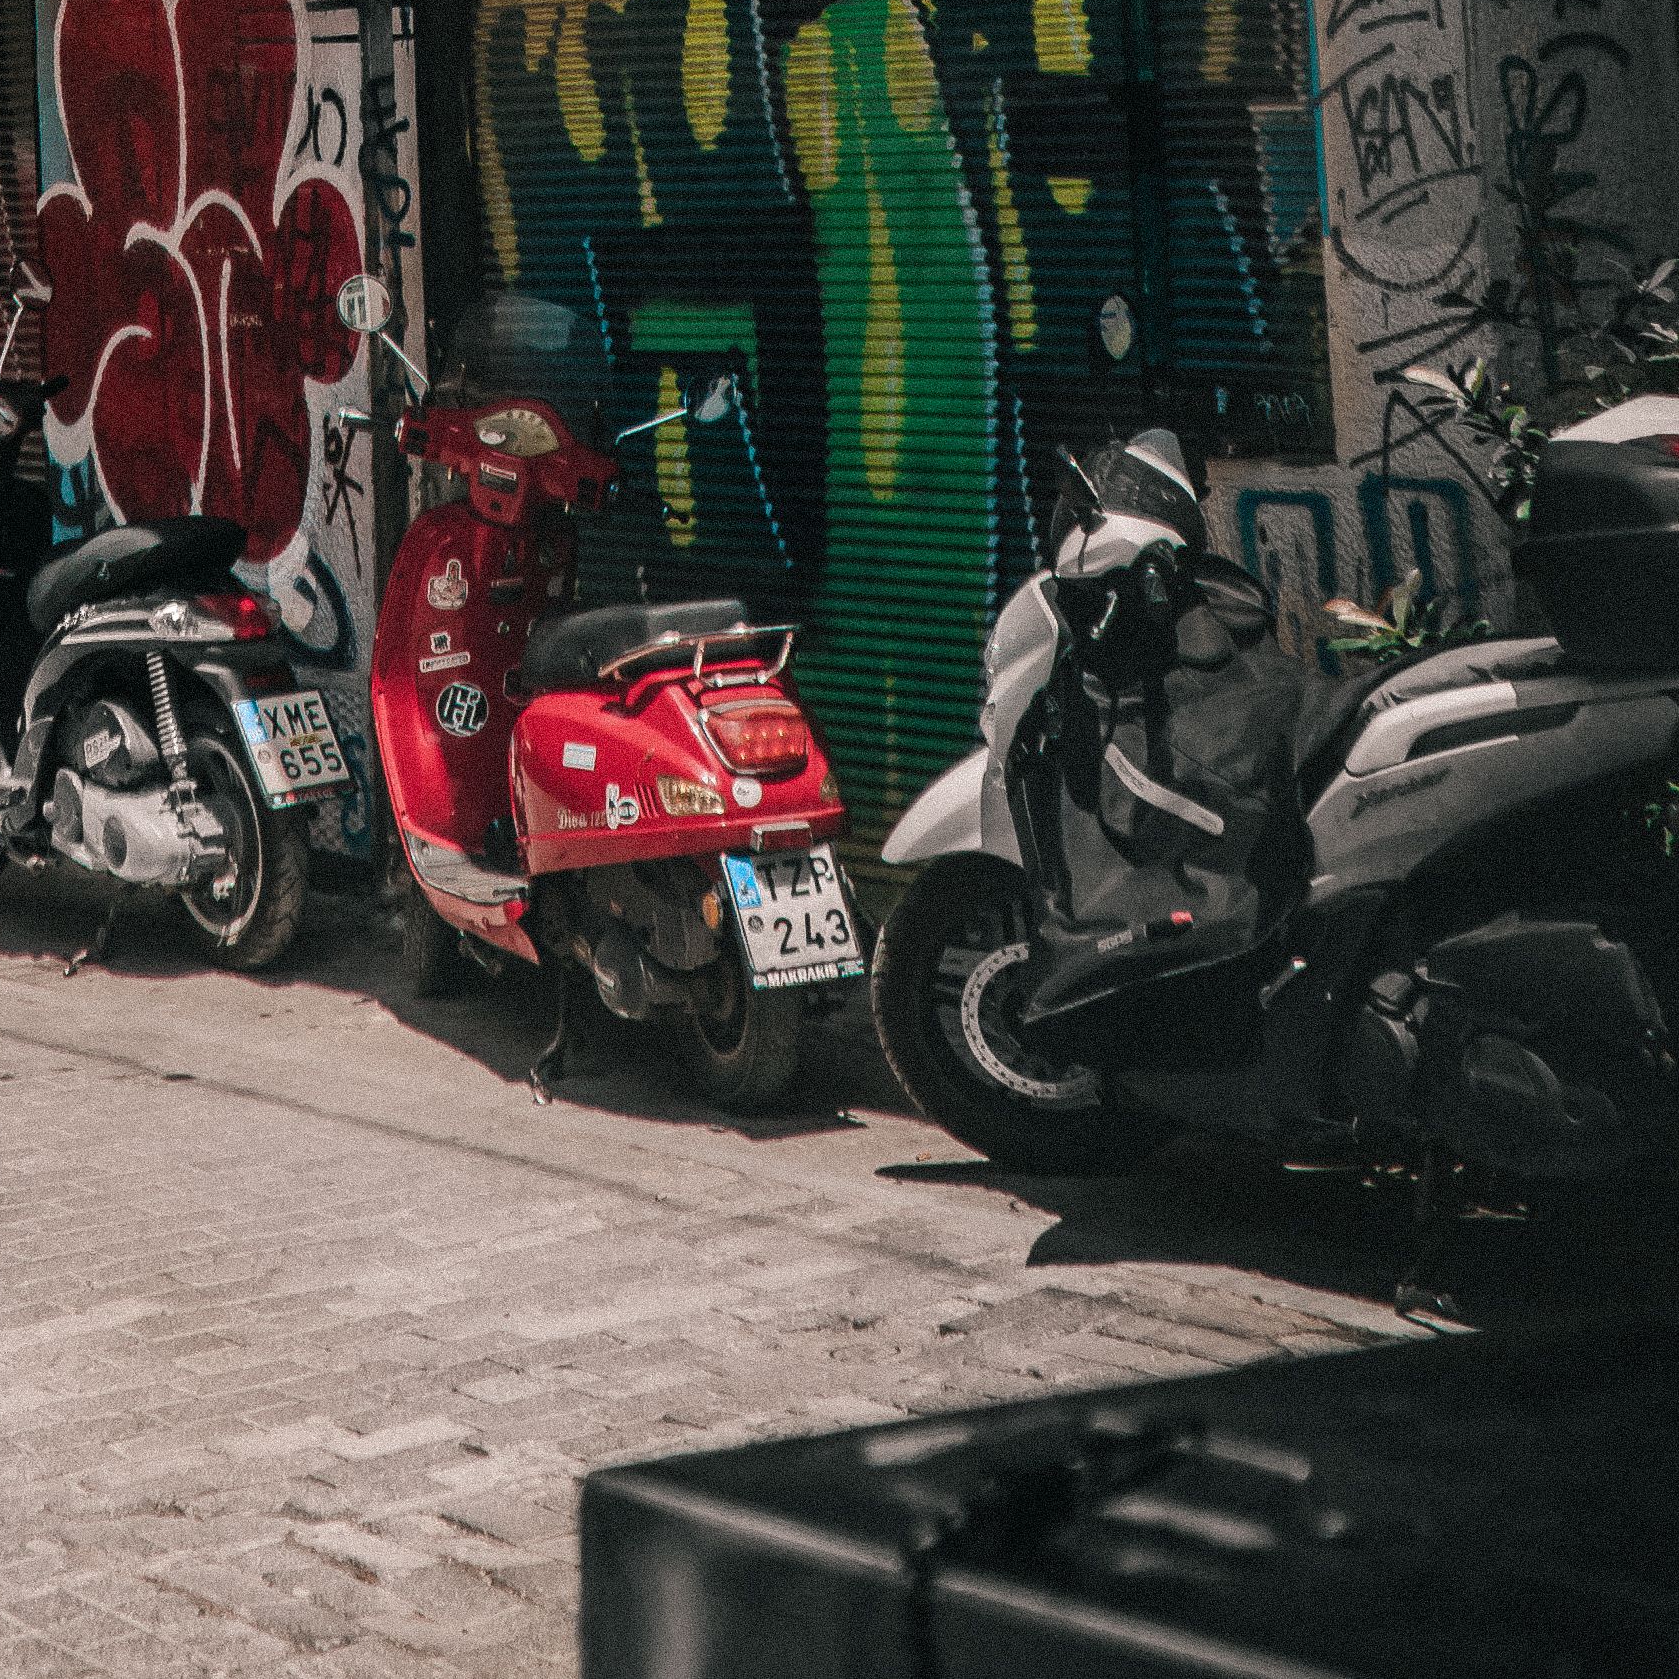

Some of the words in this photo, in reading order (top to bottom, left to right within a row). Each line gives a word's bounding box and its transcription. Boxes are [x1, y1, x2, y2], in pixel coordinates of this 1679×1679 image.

[264, 700, 328, 739] XME
[280, 741, 342, 779] 655
[757, 856, 833, 902] TZP
[773, 909, 850, 955] 243
